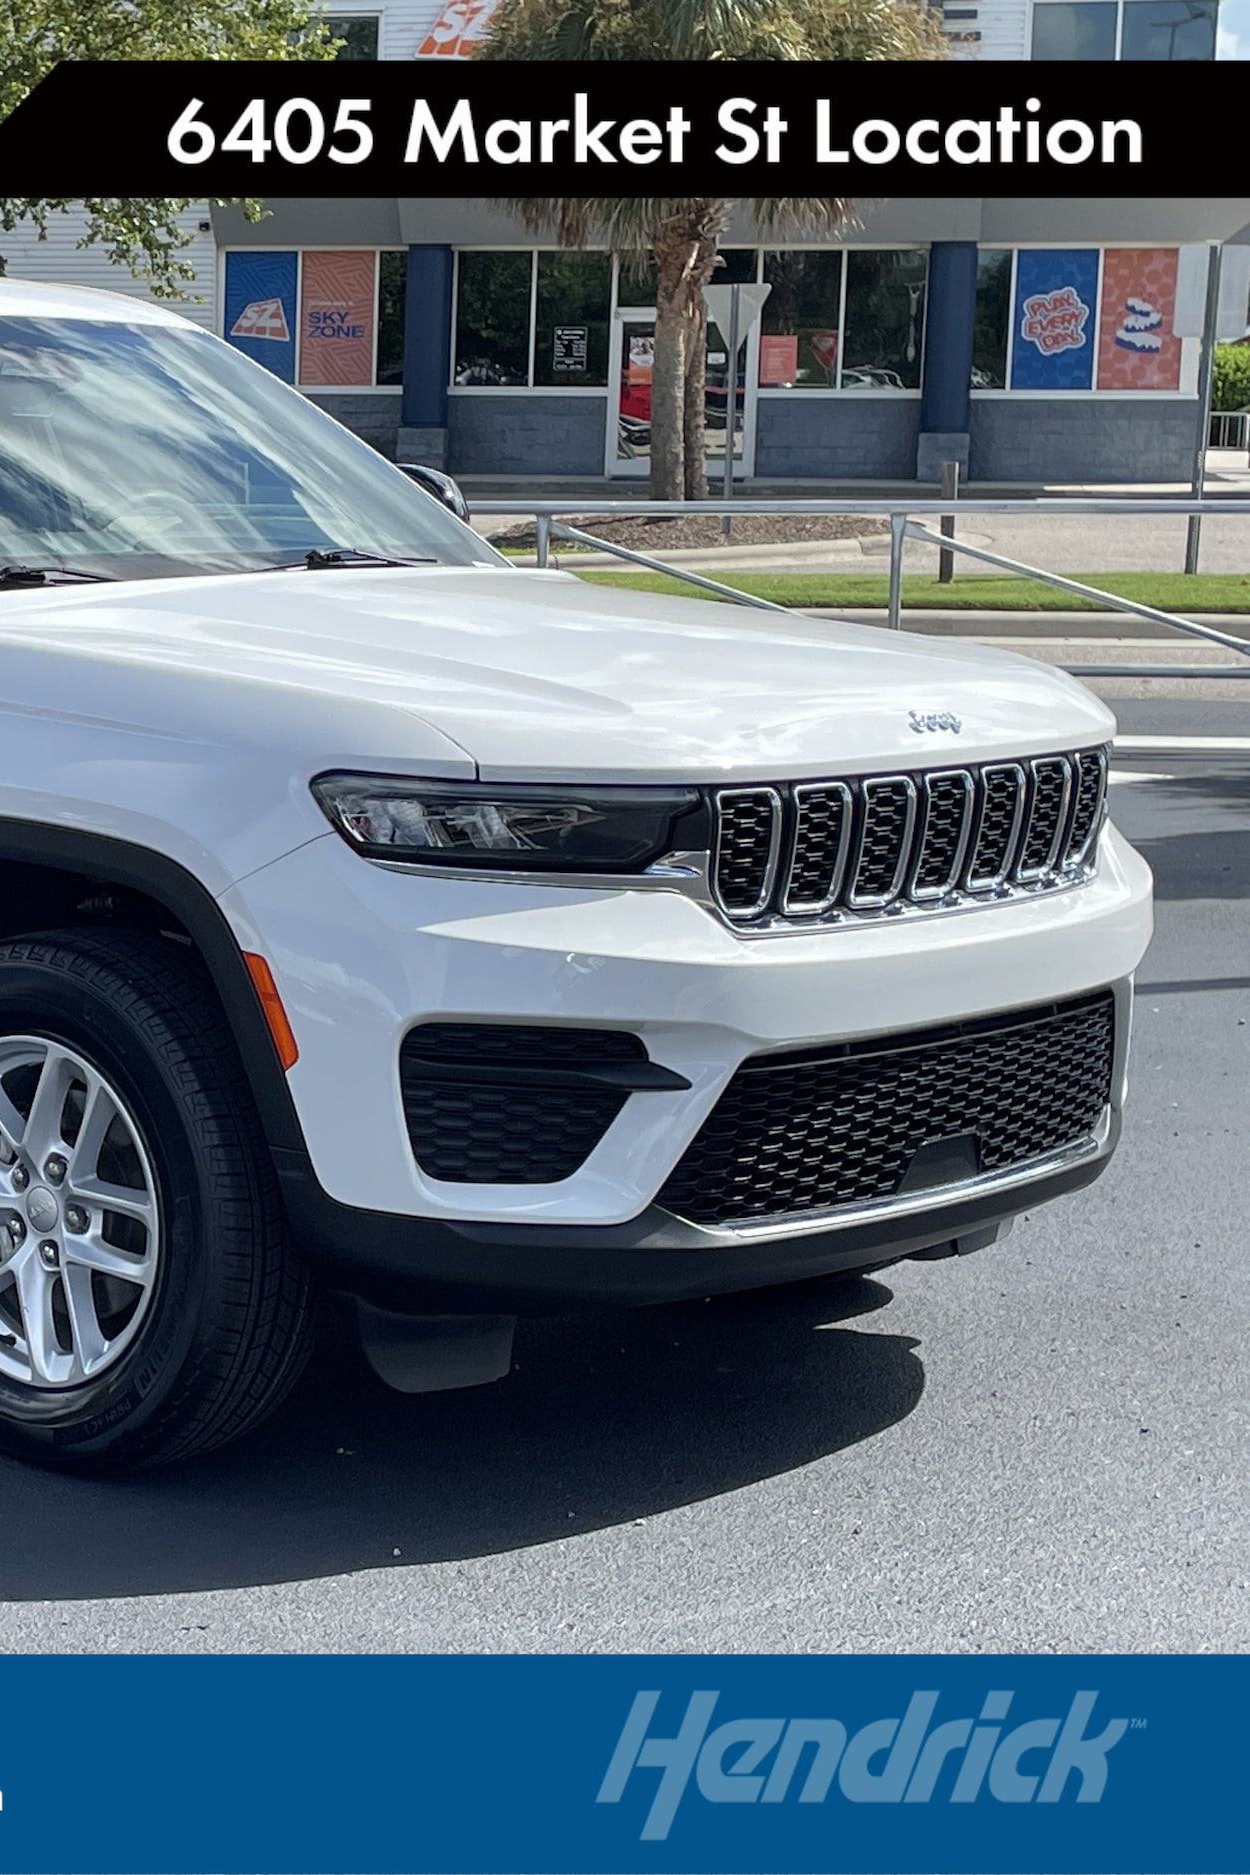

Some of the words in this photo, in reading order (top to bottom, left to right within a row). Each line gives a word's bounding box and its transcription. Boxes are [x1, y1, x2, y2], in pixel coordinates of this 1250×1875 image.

[241, 303, 281, 327] SZ
[1030, 293, 1074, 316] PLAY
[308, 311, 349, 324] SKY
[1028, 311, 1082, 335] EVERY
[308, 324, 365, 338] ZONE
[1041, 328, 1080, 349] DAY
[908, 709, 962, 734] Jeep
